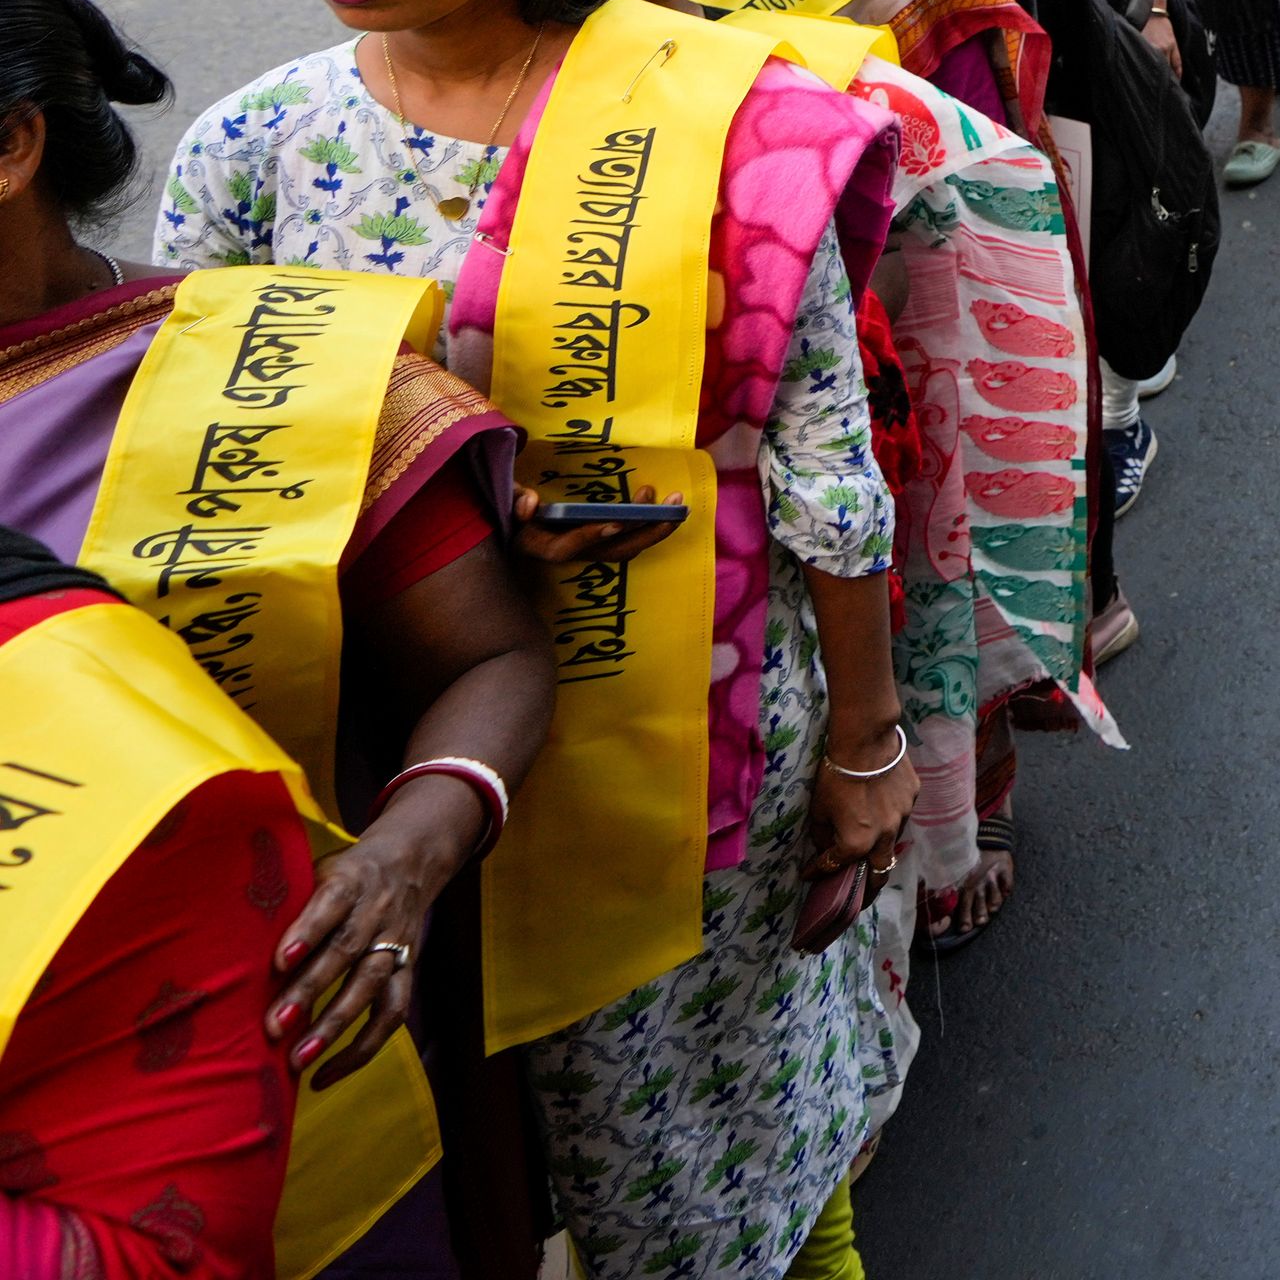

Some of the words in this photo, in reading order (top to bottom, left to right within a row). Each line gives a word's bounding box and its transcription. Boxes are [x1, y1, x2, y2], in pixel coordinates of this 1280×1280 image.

[562, 128, 656, 291] অত্যাচারের
[222, 272, 349, 410] একসাথে।
[540, 300, 650, 408] বিরুদ্ধে,
[176, 423, 314, 521] পুরুষ
[552, 560, 637, 684] কসাথে।
